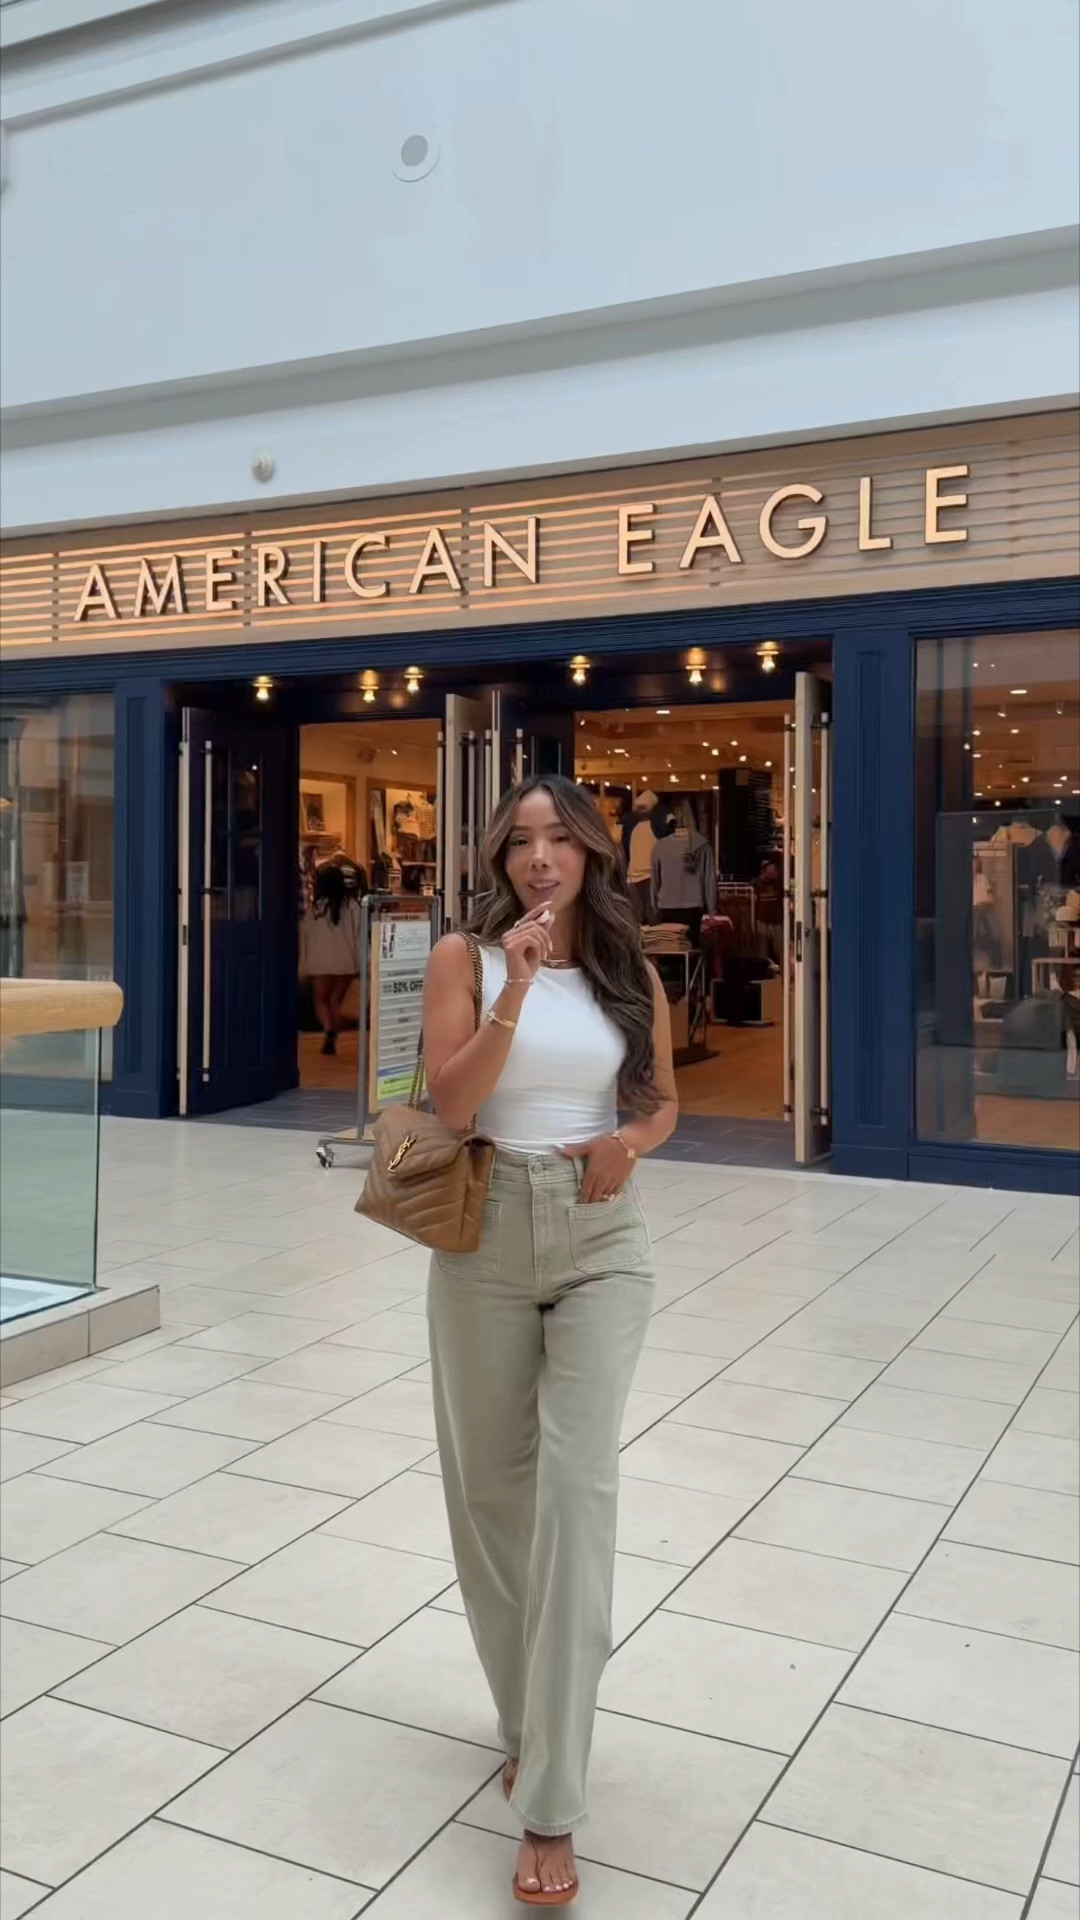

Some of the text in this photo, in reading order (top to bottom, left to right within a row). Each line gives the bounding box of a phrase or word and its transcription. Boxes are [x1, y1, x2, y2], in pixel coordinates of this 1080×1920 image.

[74, 464, 970, 621] AMERICAN EAGLE
[393, 982, 408, 993] 50%
[410, 980, 424, 992] OFF
